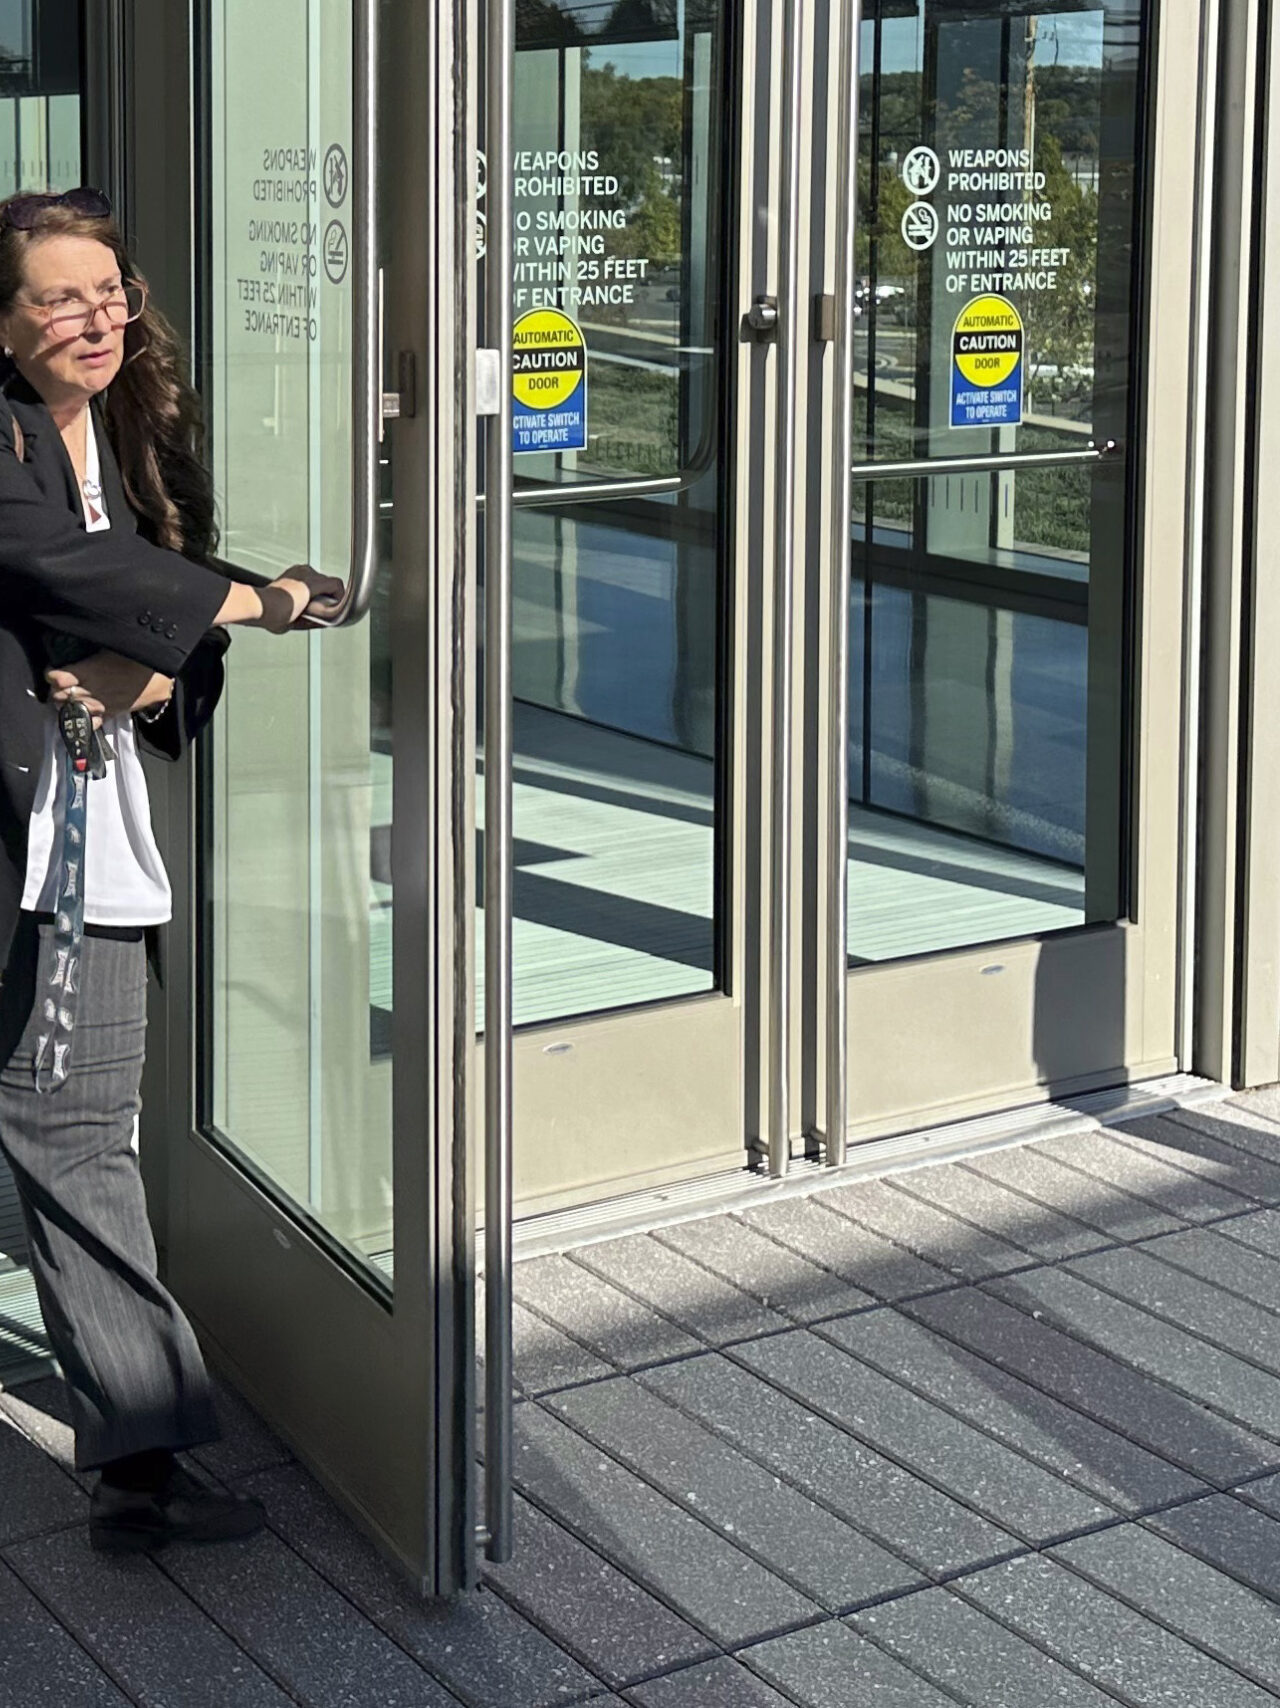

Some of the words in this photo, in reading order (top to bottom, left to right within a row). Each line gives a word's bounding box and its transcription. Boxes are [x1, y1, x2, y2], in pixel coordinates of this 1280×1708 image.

[514, 151, 599, 171] EAPONS
[948, 149, 1030, 168] WEAPONS
[514, 176, 618, 197] ROHIBITED
[948, 172, 1046, 191] PROHIBITED
[514, 211, 531, 231] O
[536, 210, 626, 230] SMOKING
[947, 204, 971, 223] NO
[975, 202, 1051, 222] SMOKING
[514, 236, 529, 256] R
[534, 235, 605, 256] VAPING
[946, 227, 970, 246] OR
[973, 226, 1033, 245] VAPING
[946, 250, 1004, 269] WITHIN
[1008, 249, 1028, 268] 25
[1032, 248, 1070, 267] FEET
[513, 262, 571, 282] ITHIN
[577, 261, 599, 280] 25
[604, 259, 649, 279] FEET
[946, 274, 968, 293] OF
[971, 272, 1057, 292] ENTRANCE
[513, 288, 527, 308] F
[532, 285, 634, 307] ENTRANCE
[963, 315, 1014, 327] AUTOMATIC
[513, 330, 574, 344] AUTOMATIC
[960, 335, 1016, 351] CAUTION
[512, 352, 577, 370] CAUTION
[975, 358, 1000, 369] DOOR
[529, 377, 559, 390] DOOR
[956, 391, 989, 405] ACTIVATE
[990, 390, 1017, 404] SWITCH
[513, 415, 546, 429] CTIVATE
[548, 412, 580, 426] SWITCH
[966, 406, 975, 419] TO
[976, 405, 1007, 418] OPERATE
[519, 431, 530, 445] TO
[532, 429, 569, 444] OPERATE
